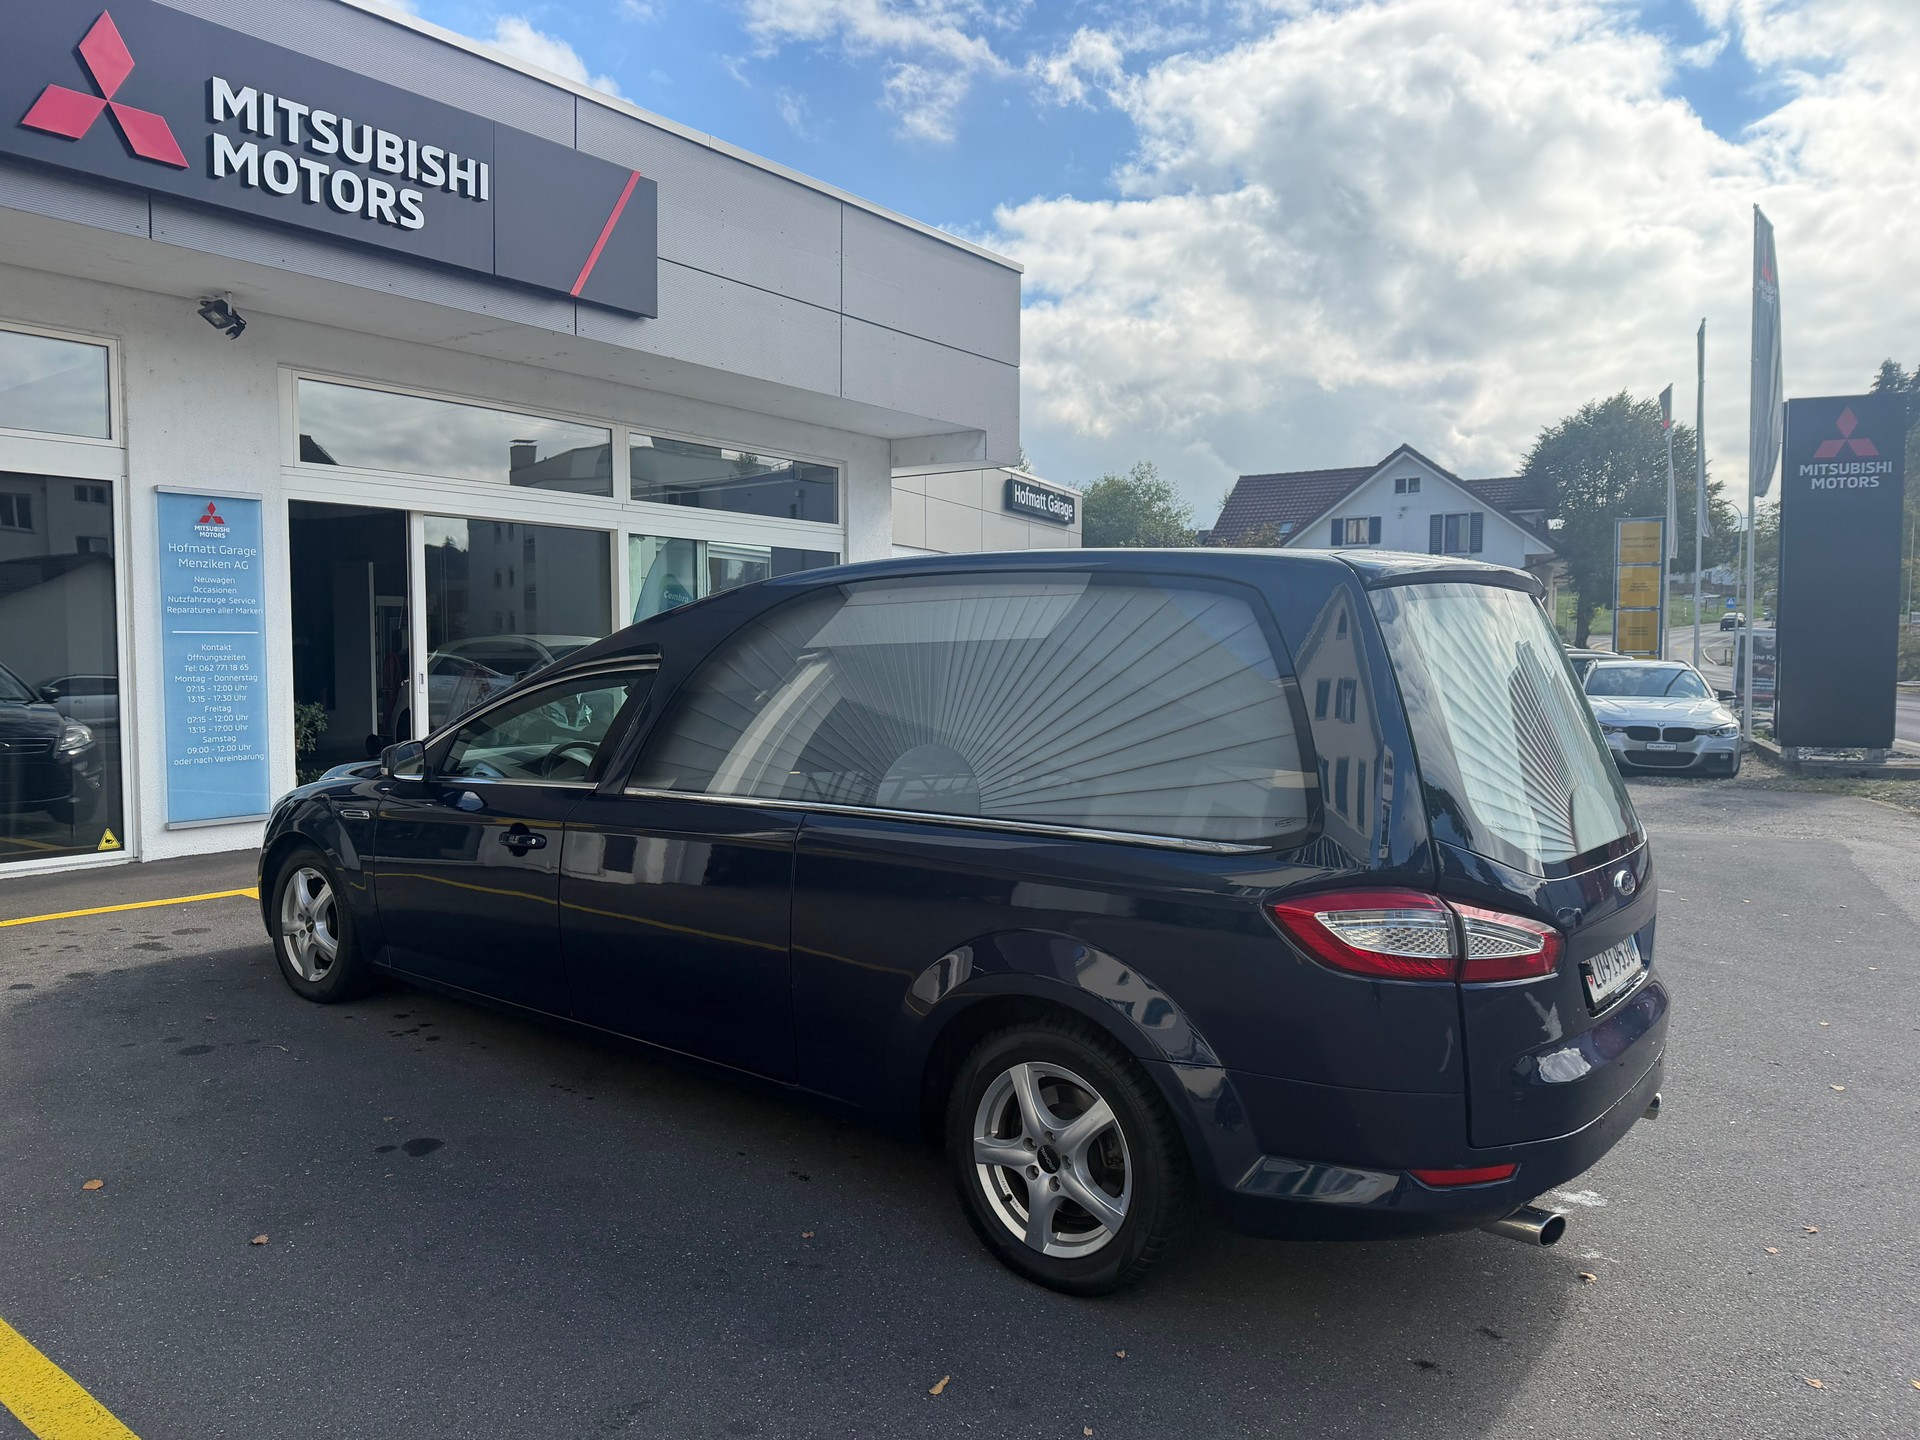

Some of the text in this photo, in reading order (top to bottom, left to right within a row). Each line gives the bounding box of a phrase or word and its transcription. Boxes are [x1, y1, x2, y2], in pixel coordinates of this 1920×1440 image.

[211, 76, 489, 201] MITSUBISHI
[212, 133, 424, 230] MOTORS
[1799, 461, 1892, 476] MITSUBISHI
[1811, 476, 1880, 489] MOTORS
[1014, 484, 1073, 520] Hofmatt Garage
[194, 525, 230, 533] MITSUBISHI
[199, 531, 226, 539] MOTORS
[168, 543, 257, 557] Hofmatt Garage
[178, 558, 249, 570] Menziken AG
[194, 576, 236, 585] Neuwagen
[192, 586, 238, 594] Occasionen
[167, 595, 256, 605] Nutzfahrzeuge Service
[663, 590, 690, 603] Cembra
[166, 606, 216, 615] Reparaturen
[235, 607, 264, 615] Marken
[186, 653, 246, 663] Öffnungszeiten
[198, 664, 214, 672] 062
[239, 663, 249, 671] 65
[175, 675, 206, 684] Montag
[214, 674, 258, 683] Donnerstag
[187, 695, 206, 703] 13:15
[204, 705, 232, 713] Freitag
[186, 716, 207, 724] 07:15
[188, 726, 206, 734] 13:15
[202, 735, 237, 743] Samstag
[193, 756, 213, 764] nach
[214, 753, 265, 763] Vereinbarung
